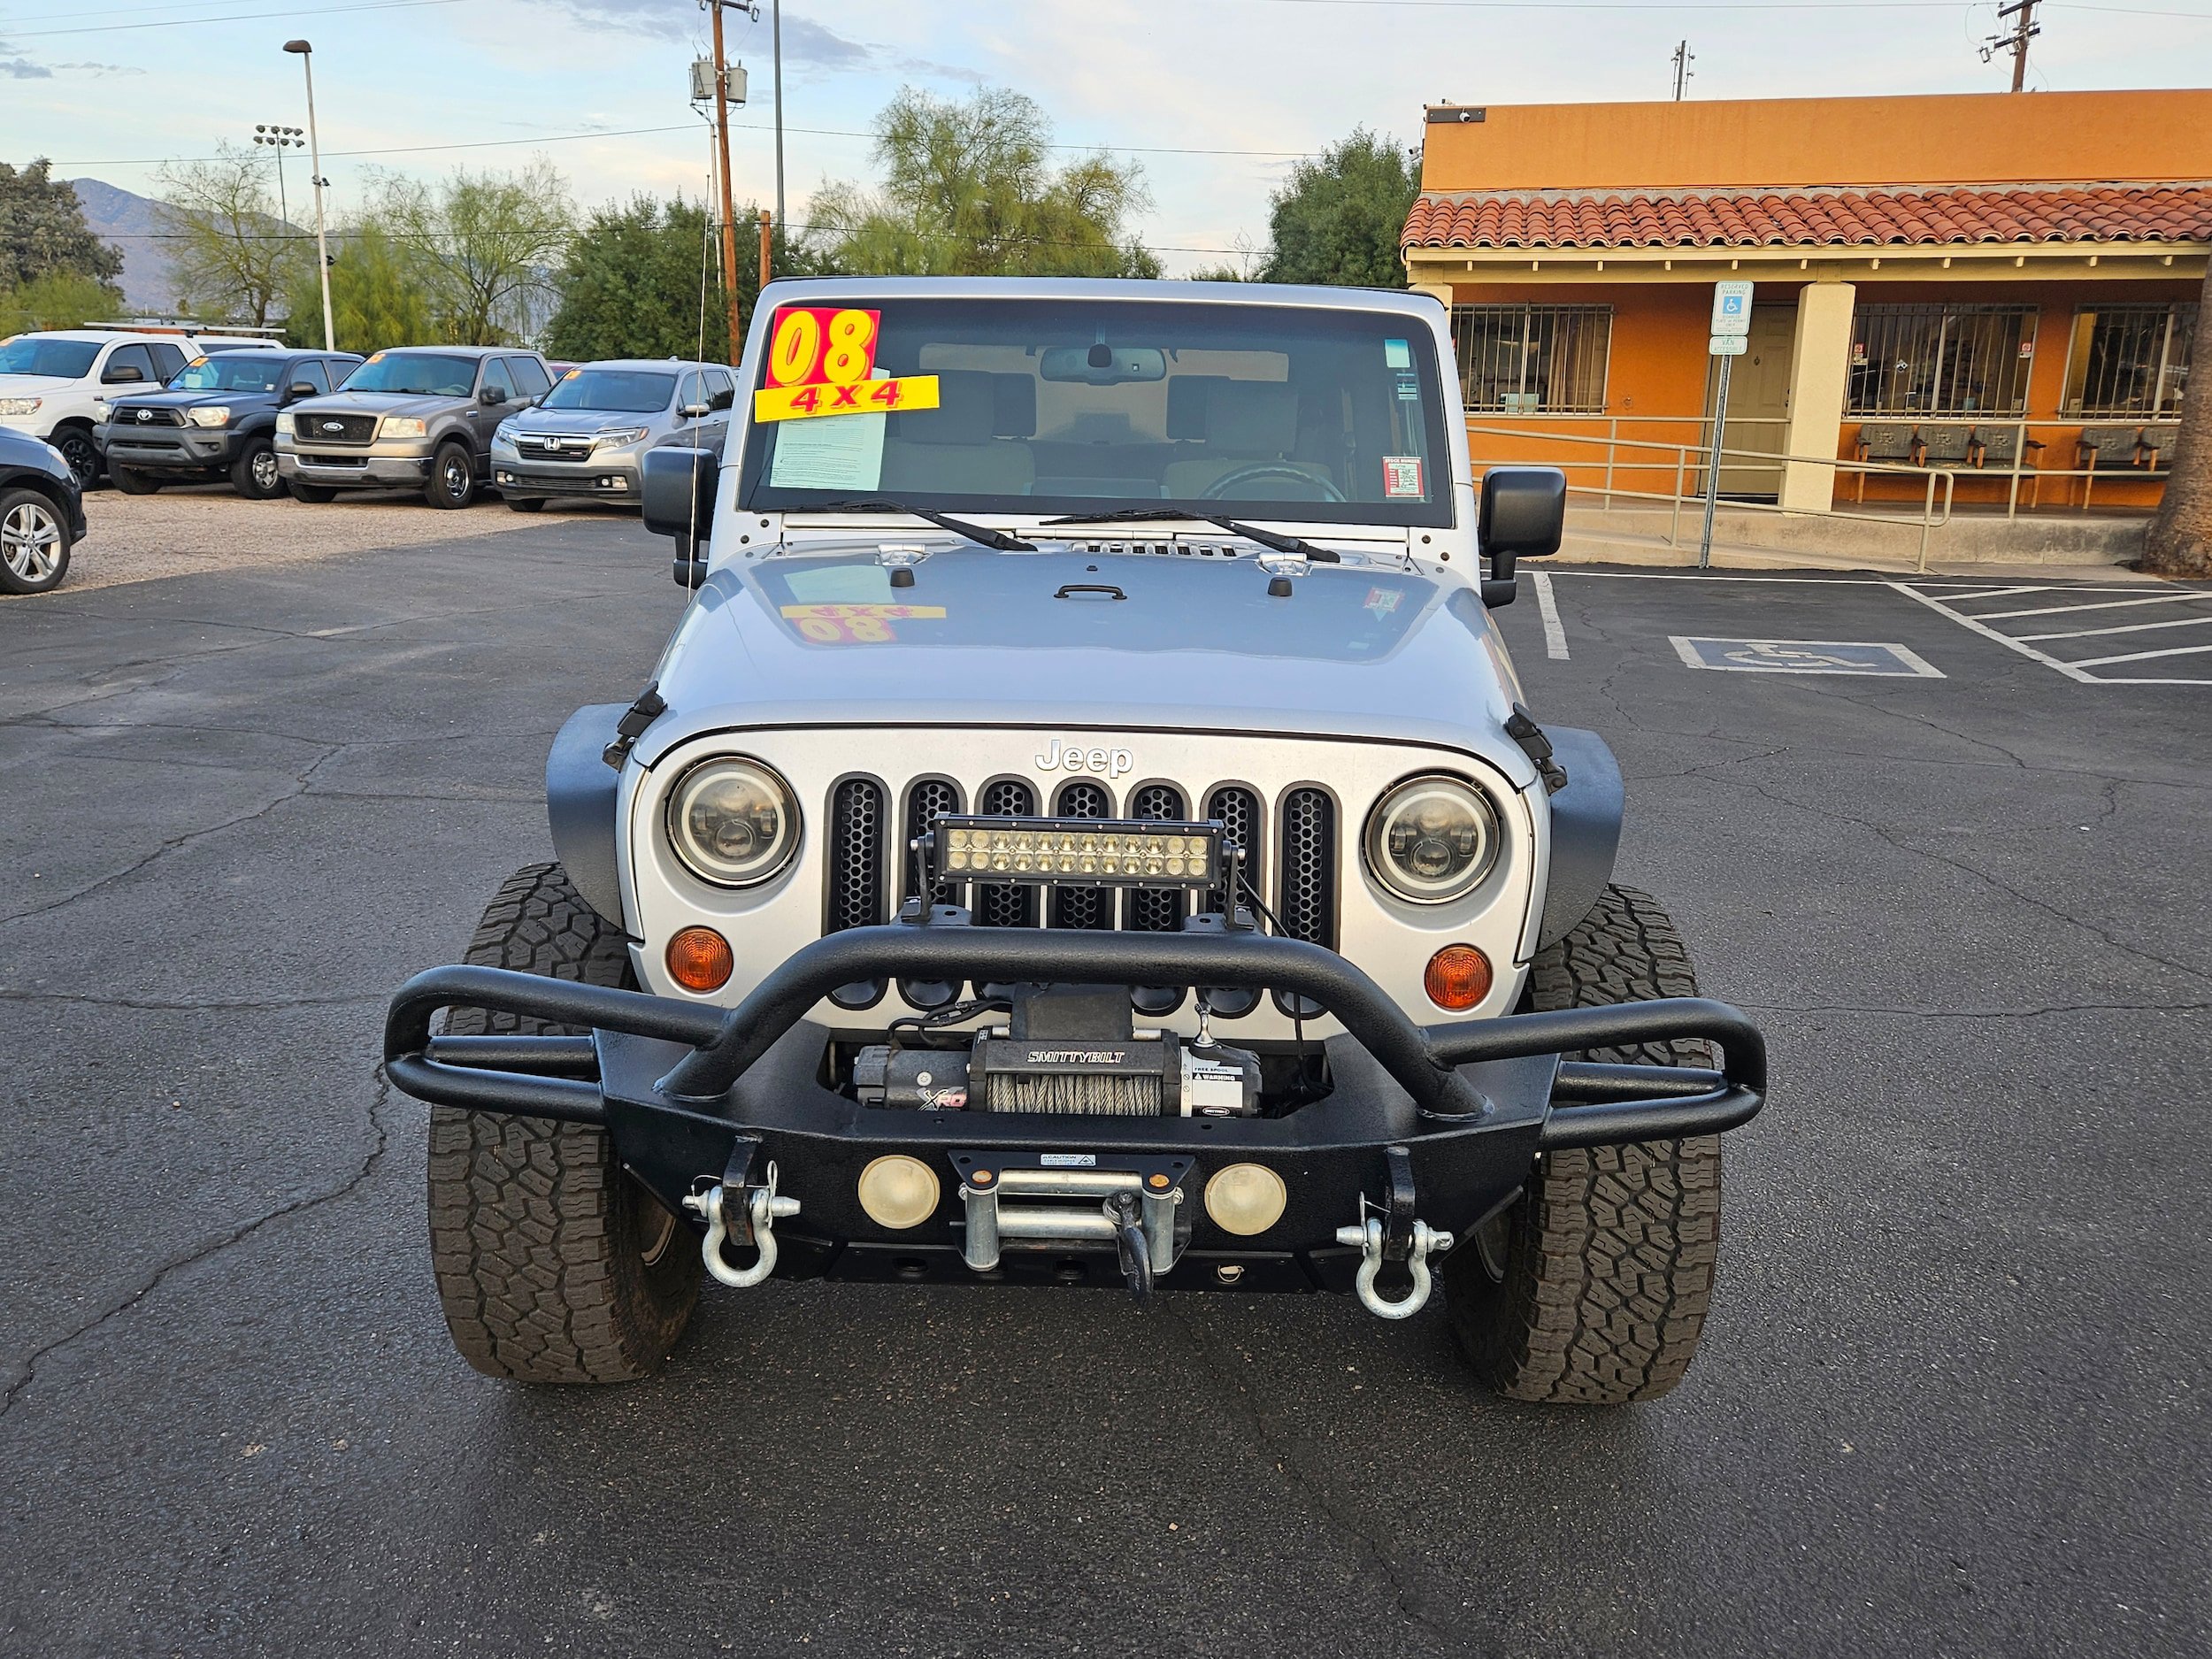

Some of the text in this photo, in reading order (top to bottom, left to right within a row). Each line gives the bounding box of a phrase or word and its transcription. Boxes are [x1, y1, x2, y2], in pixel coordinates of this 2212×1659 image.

[771, 309, 874, 386] 08
[1034, 739, 1133, 779] Jeep
[1027, 1051, 1125, 1064] SMITTYBILT
